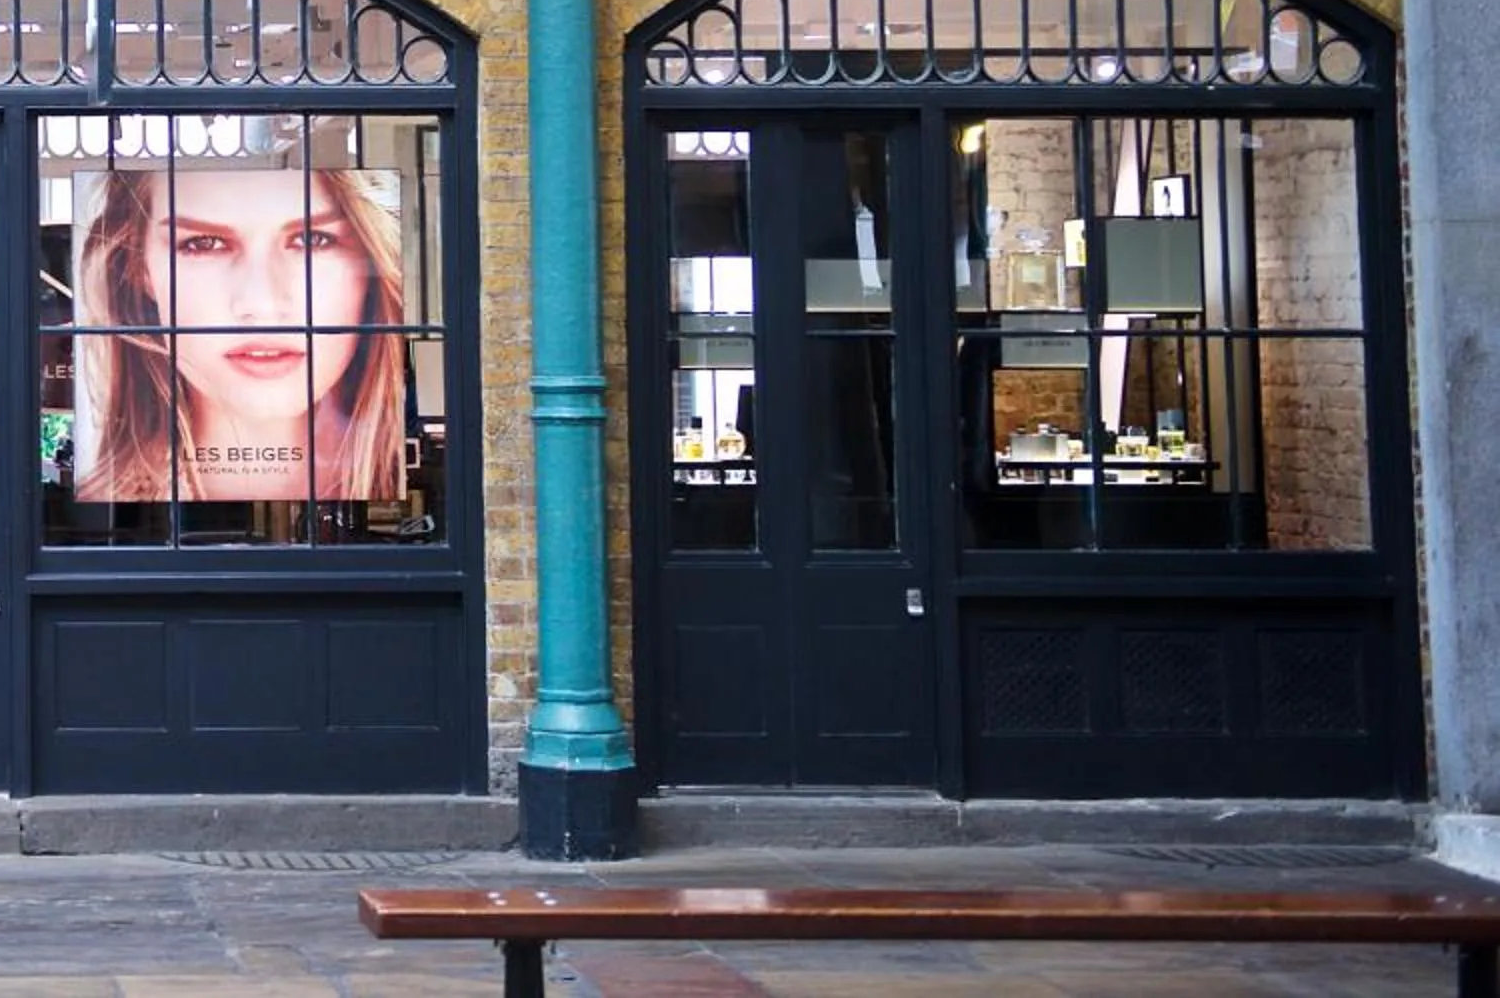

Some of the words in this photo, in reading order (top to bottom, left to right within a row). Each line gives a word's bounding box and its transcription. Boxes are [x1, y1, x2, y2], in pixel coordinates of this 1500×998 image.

[43, 364, 75, 379] LES
[183, 447, 221, 462] LES
[227, 447, 304, 462] BEIGES
[197, 465, 238, 476] NATURAL
[261, 465, 289, 475] STYLE
